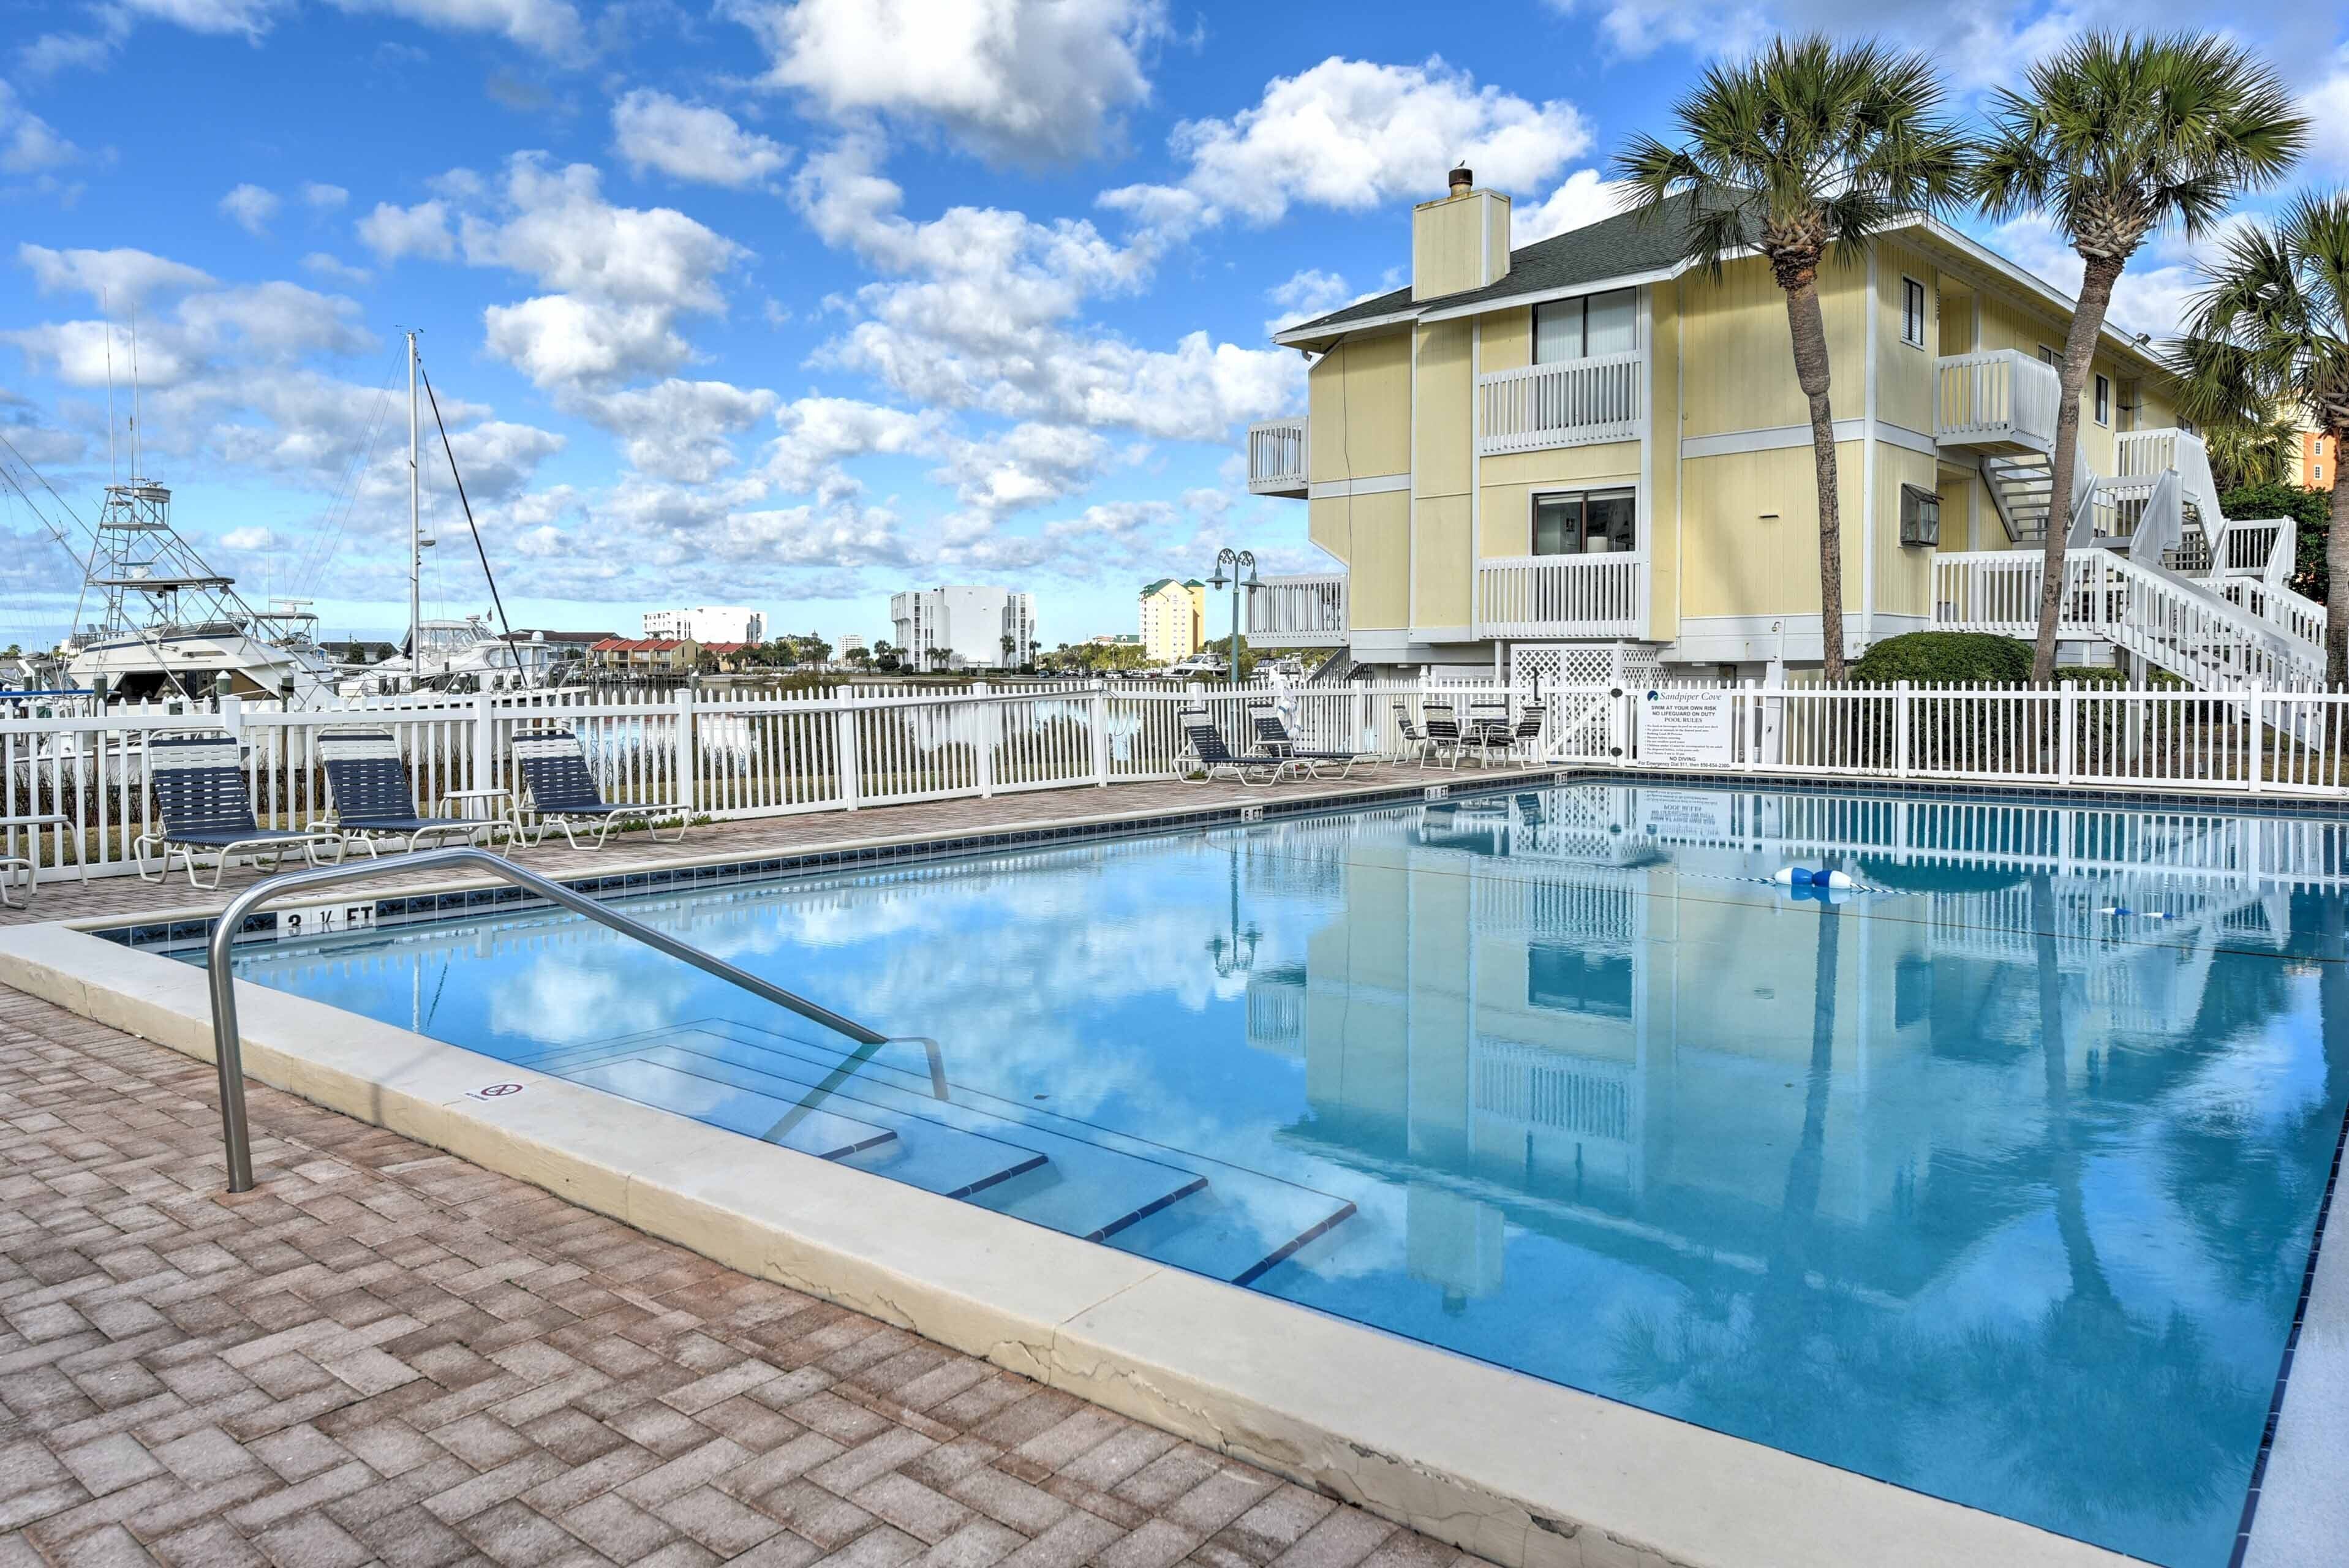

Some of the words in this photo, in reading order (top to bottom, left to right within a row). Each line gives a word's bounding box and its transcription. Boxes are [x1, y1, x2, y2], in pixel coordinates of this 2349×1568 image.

[1659, 692, 1700, 703] Sandpiper
[1701, 692, 1722, 701] Cove
[347, 906, 373, 921] FT
